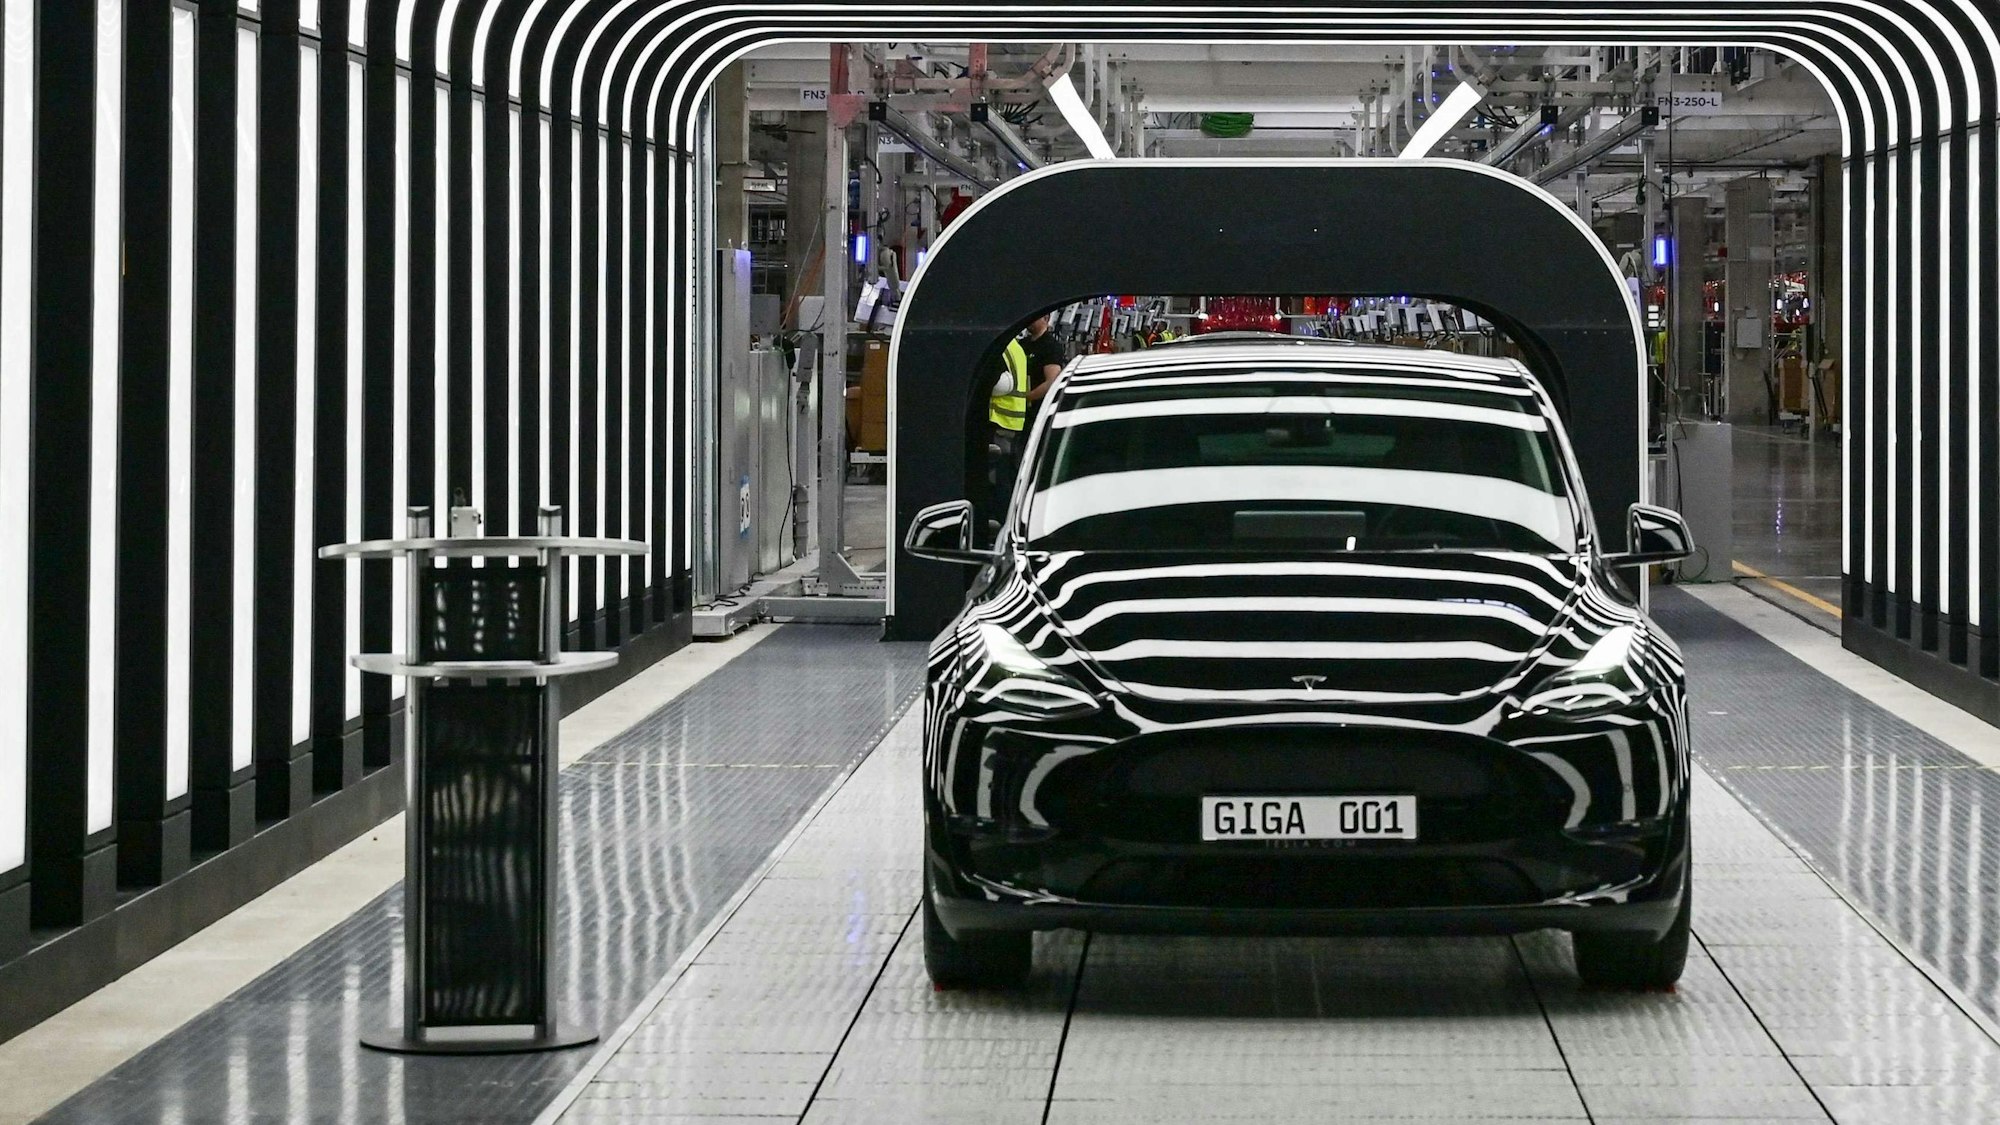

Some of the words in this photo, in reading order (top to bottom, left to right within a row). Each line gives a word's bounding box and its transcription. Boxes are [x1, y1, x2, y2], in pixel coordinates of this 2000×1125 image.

[803, 90, 826, 99] FN3
[1657, 97, 1719, 107] FN3-250-L
[1214, 801, 1306, 835] GIGA
[1339, 801, 1404, 834] 001
